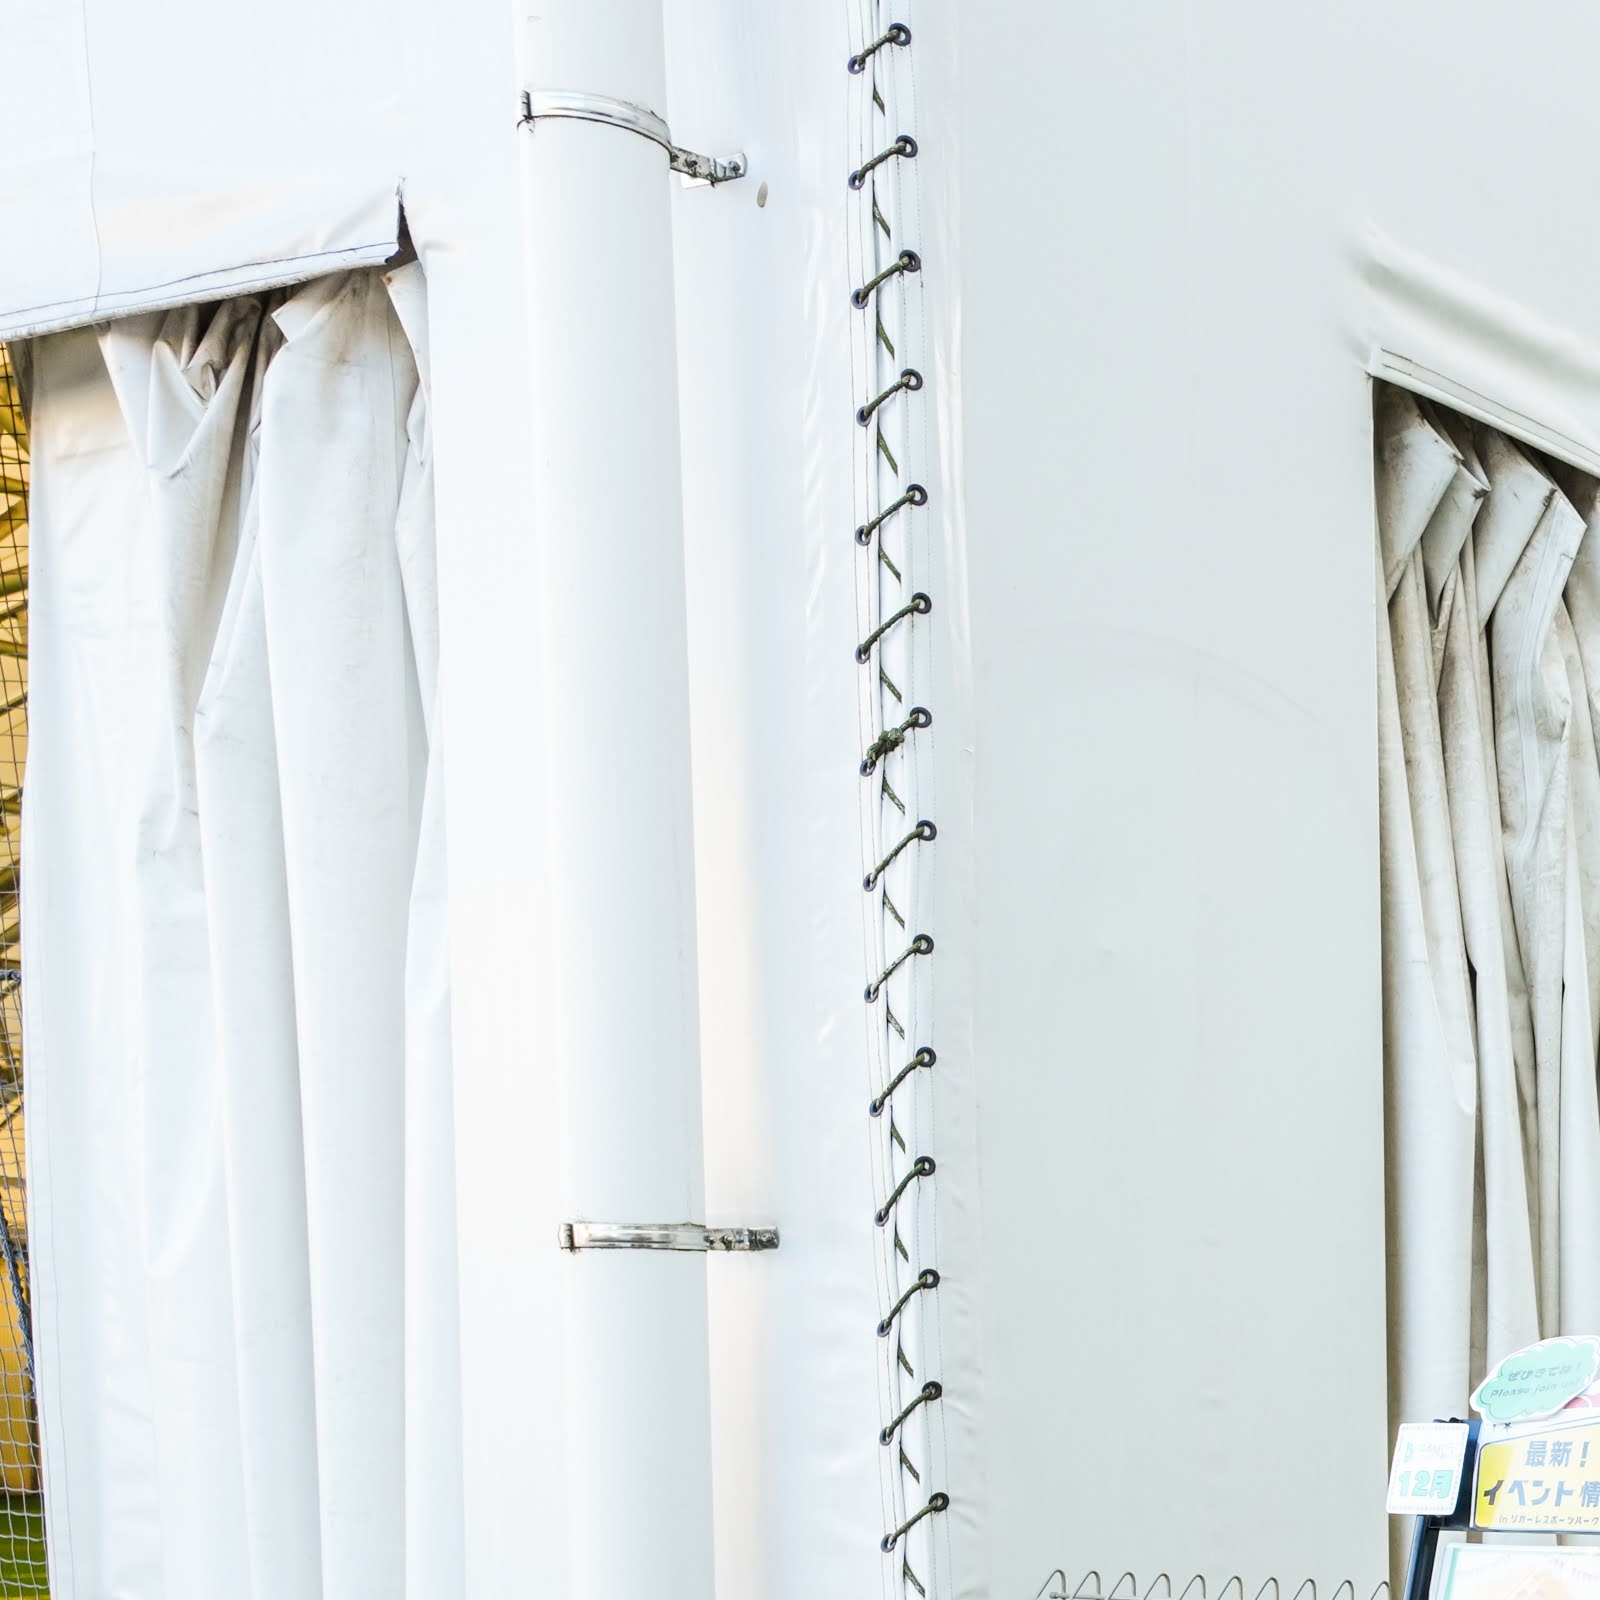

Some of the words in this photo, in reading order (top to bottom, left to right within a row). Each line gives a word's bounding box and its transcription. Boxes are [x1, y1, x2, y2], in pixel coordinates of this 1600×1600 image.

[1490, 1386, 1530, 1399] Please
[1535, 1382, 1557, 1395] join
[1525, 1440, 1590, 1468] 最新！
[1398, 1469, 1454, 1499] 12月
